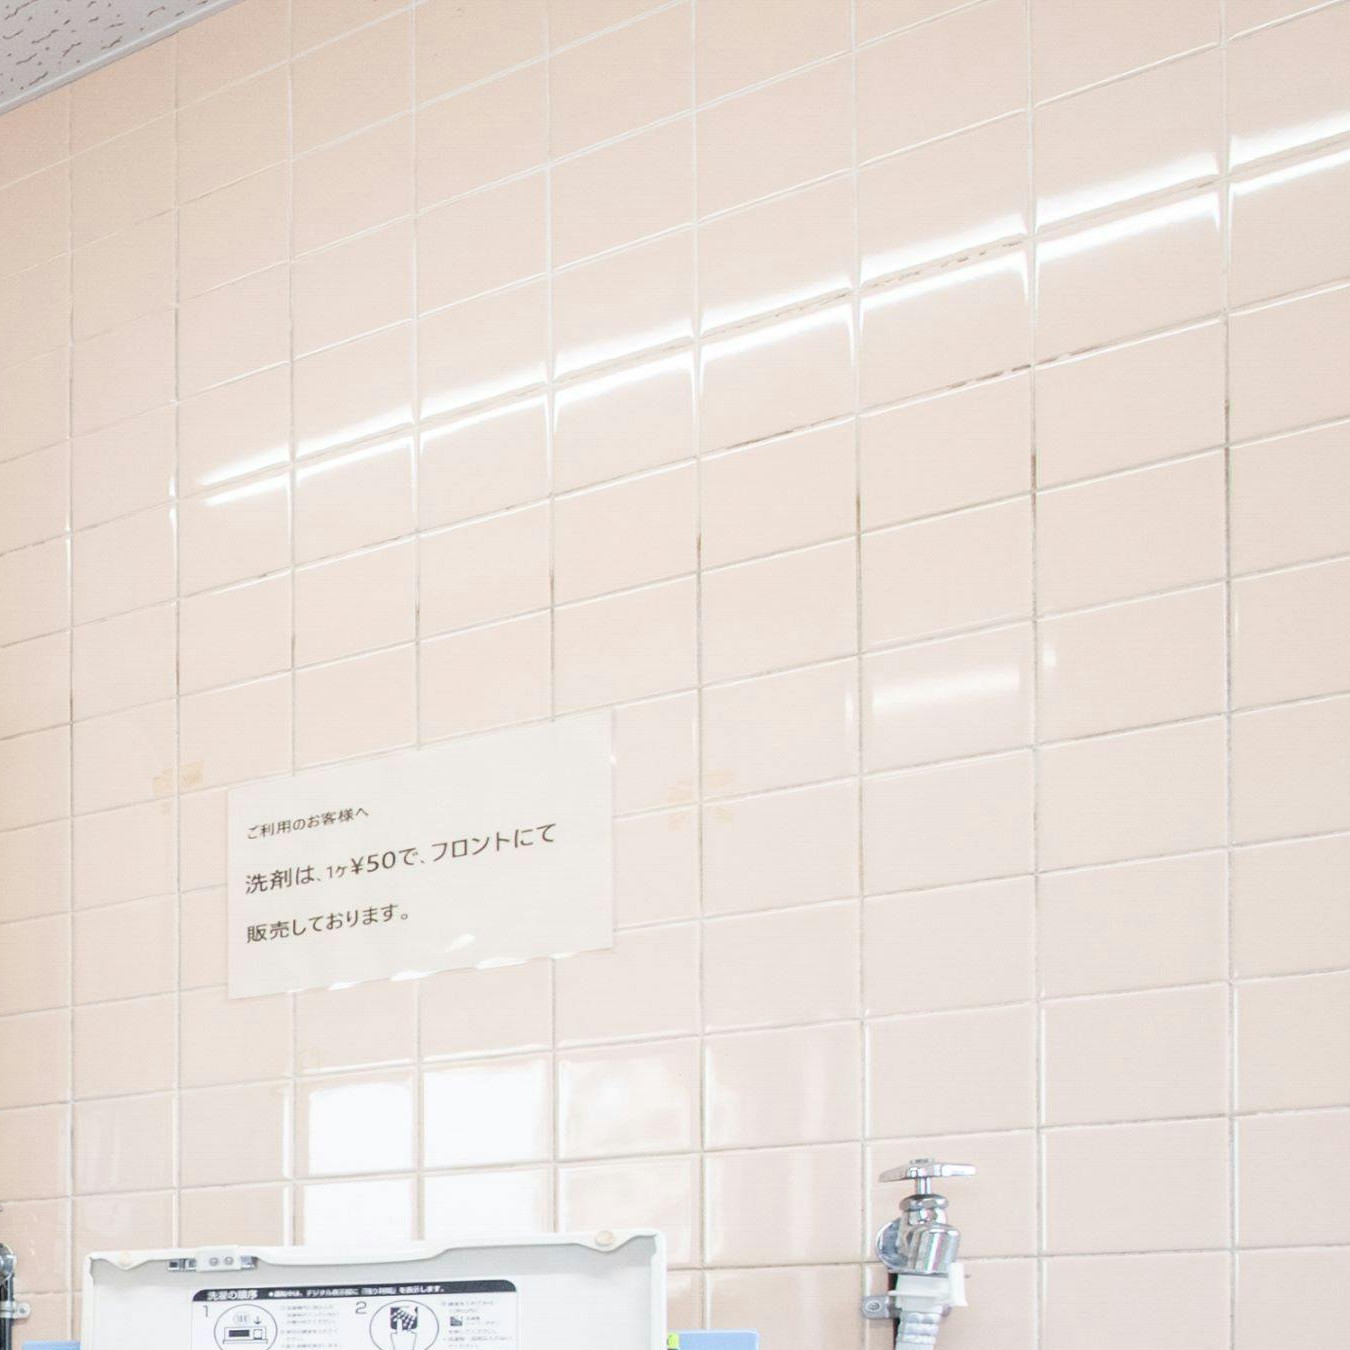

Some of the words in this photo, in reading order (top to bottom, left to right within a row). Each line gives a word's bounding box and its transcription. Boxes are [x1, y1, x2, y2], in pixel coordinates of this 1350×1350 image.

[246, 807, 370, 840] ご利用のお客様へ
[246, 903, 410, 944] 販売しております。
[355, 1301, 367, 1315] 2
